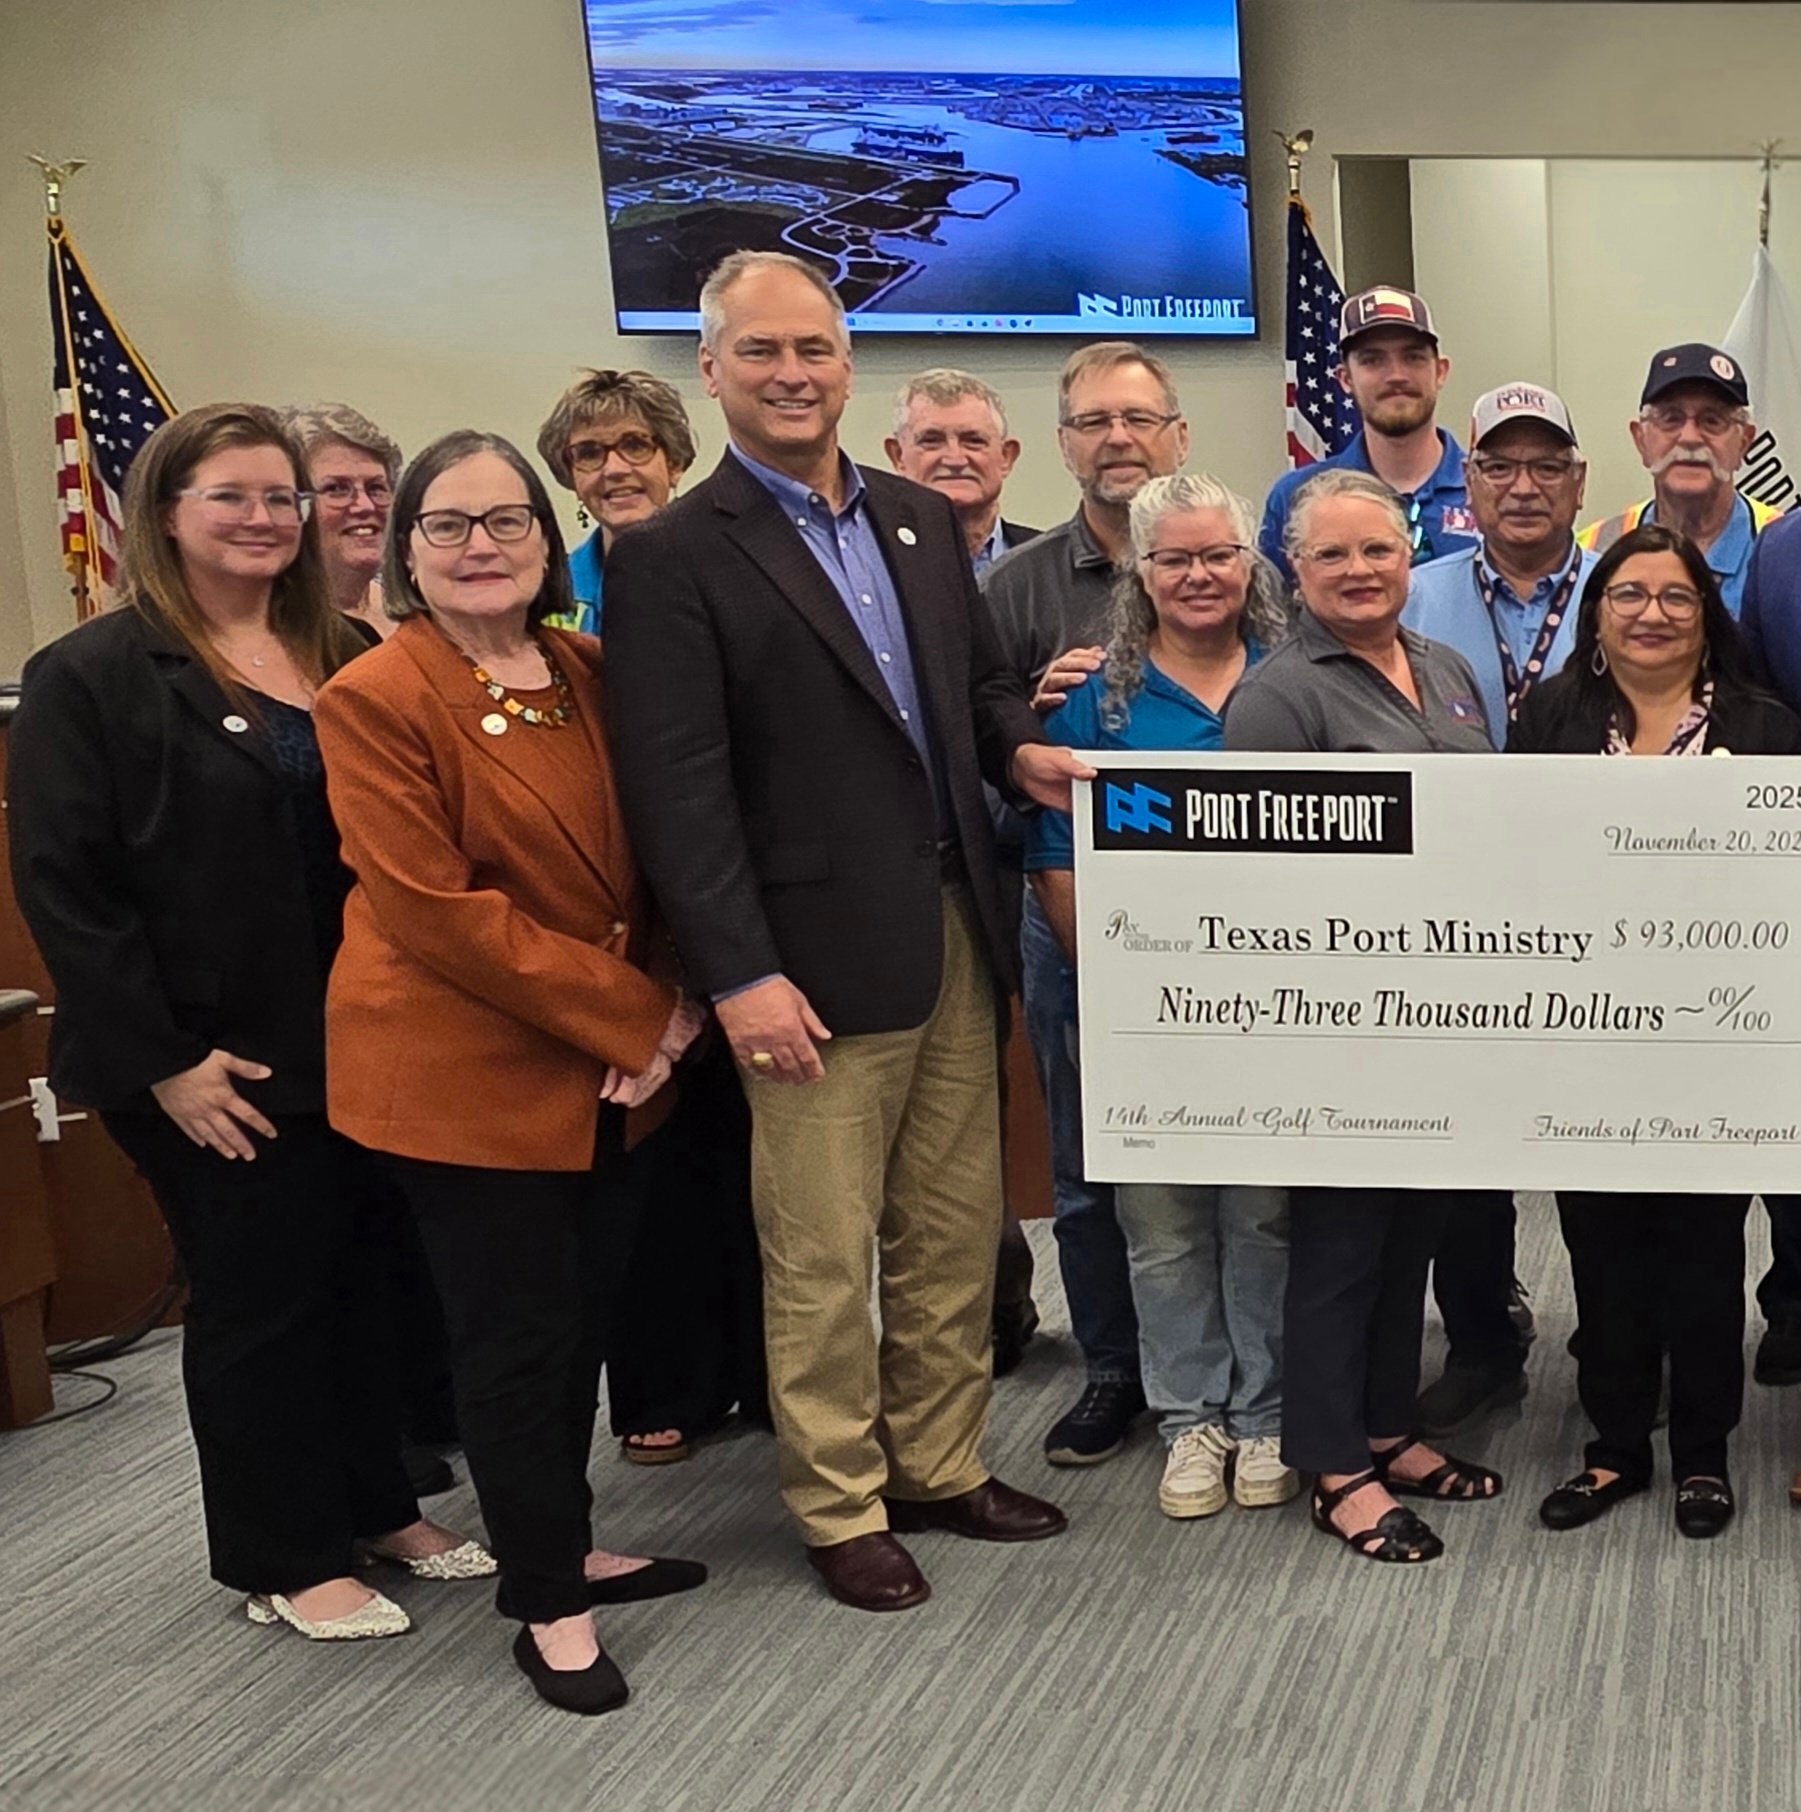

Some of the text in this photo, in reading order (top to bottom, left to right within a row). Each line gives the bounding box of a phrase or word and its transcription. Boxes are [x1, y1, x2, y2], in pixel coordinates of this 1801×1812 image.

[1186, 789, 1386, 842] PORT FREEPORT
[1603, 826, 1717, 851] November
[1725, 830, 1757, 853] 20,
[1123, 939, 1194, 952] ORDER OF
[1200, 916, 1789, 963] Texas Port Ministry $ 93,000.00
[1157, 986, 1361, 1033] Ninety-Three
[1373, 990, 1533, 1029] Thousand
[1542, 992, 1665, 1031] Dollars
[1158, 1105, 1247, 1128] Annual
[1253, 1106, 1313, 1136] Golf
[1319, 1107, 1452, 1132] Tournament
[1535, 1115, 1800, 1146] Friends of Port Freeport
[1123, 1136, 1155, 1149] Memo
